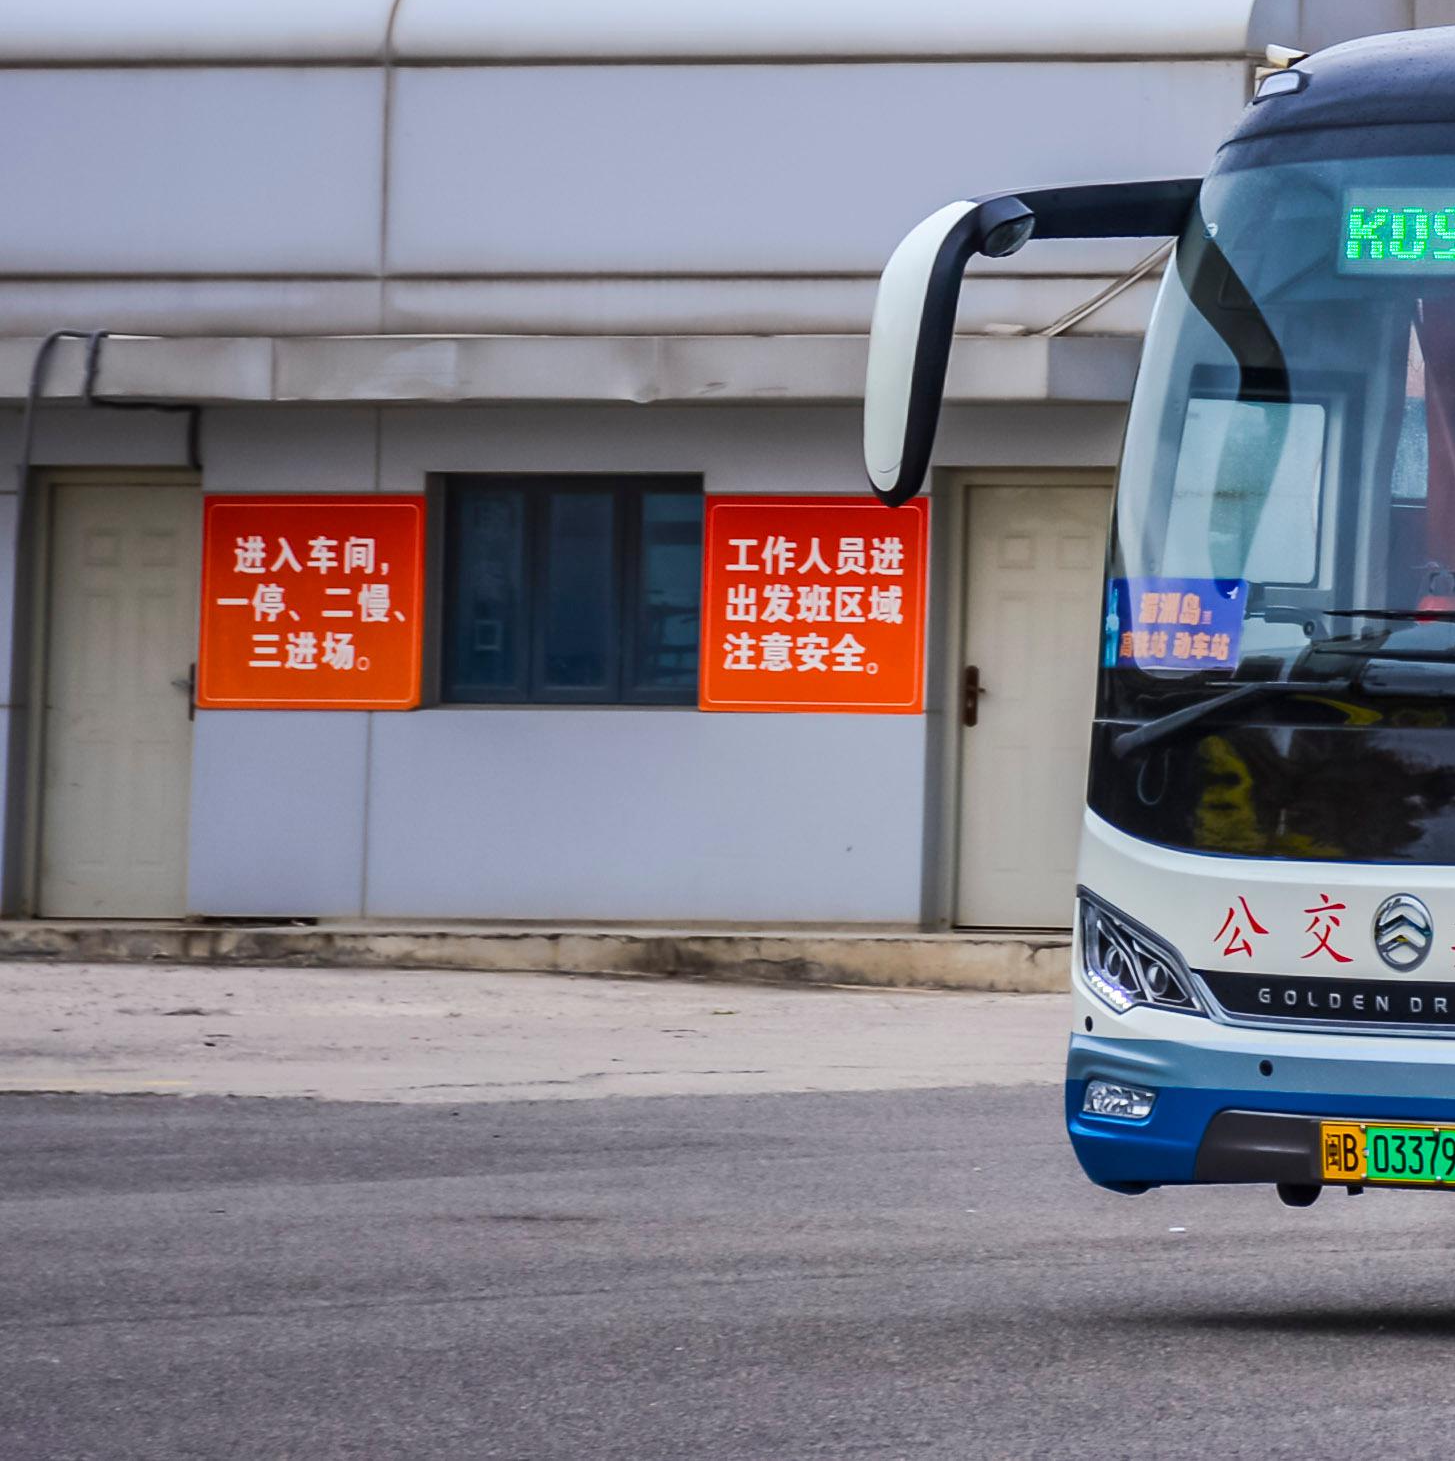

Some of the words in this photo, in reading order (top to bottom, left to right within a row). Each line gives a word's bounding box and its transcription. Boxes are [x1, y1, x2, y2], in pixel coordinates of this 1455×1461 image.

[725, 536, 904, 576] 工作人员进
[725, 583, 904, 625] 出发班区域
[248, 631, 370, 671] 三进场。
[722, 631, 880, 674] 注意安全。
[1256, 986, 1391, 1015] GOLDEN
